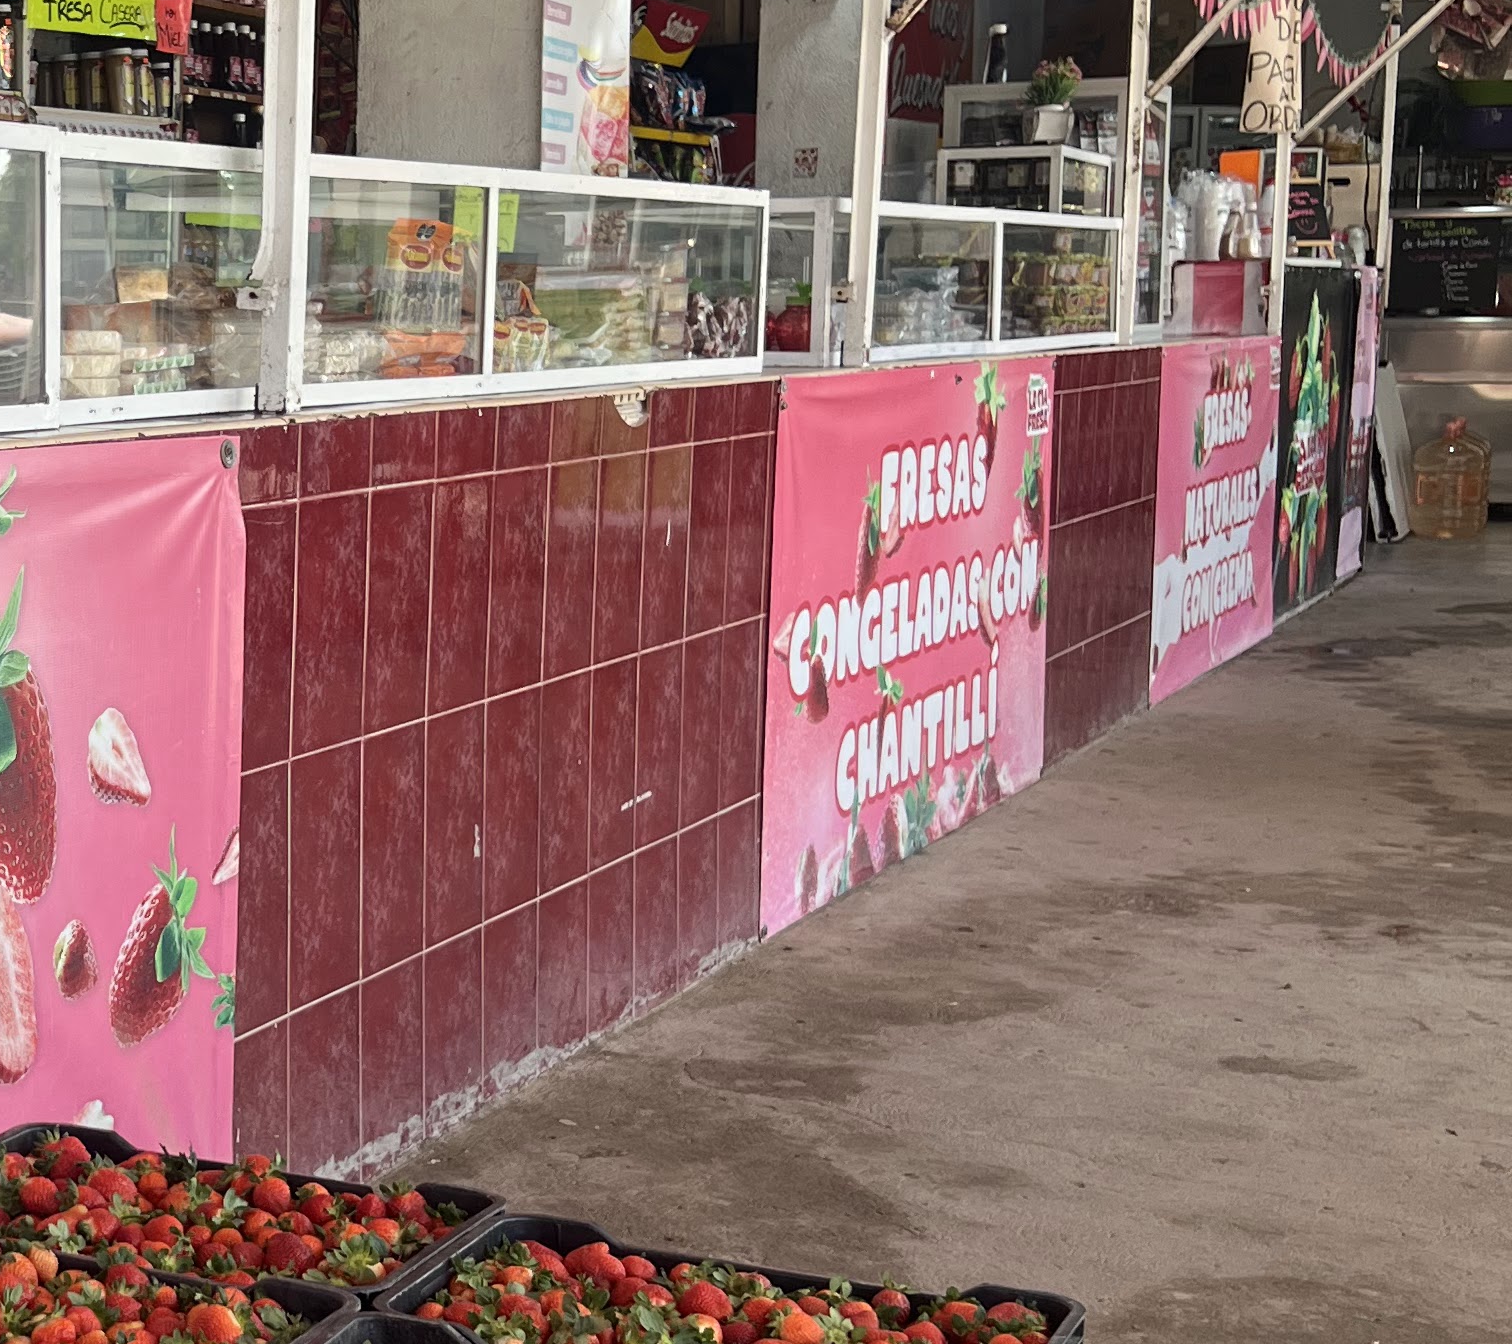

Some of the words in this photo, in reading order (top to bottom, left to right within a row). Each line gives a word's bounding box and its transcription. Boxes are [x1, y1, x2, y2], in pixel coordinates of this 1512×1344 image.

[1248, 52, 1299, 86] PAG
[1203, 387, 1252, 450] FRESAS
[880, 433, 988, 534] FRESAS
[1184, 466, 1259, 547] NATURALES
[789, 555, 981, 696] CONGELADAS
[990, 539, 1039, 622] CON
[1182, 563, 1212, 633] CON
[1213, 549, 1255, 615] CREMA
[836, 639, 1000, 812] CHANTILLÍ
